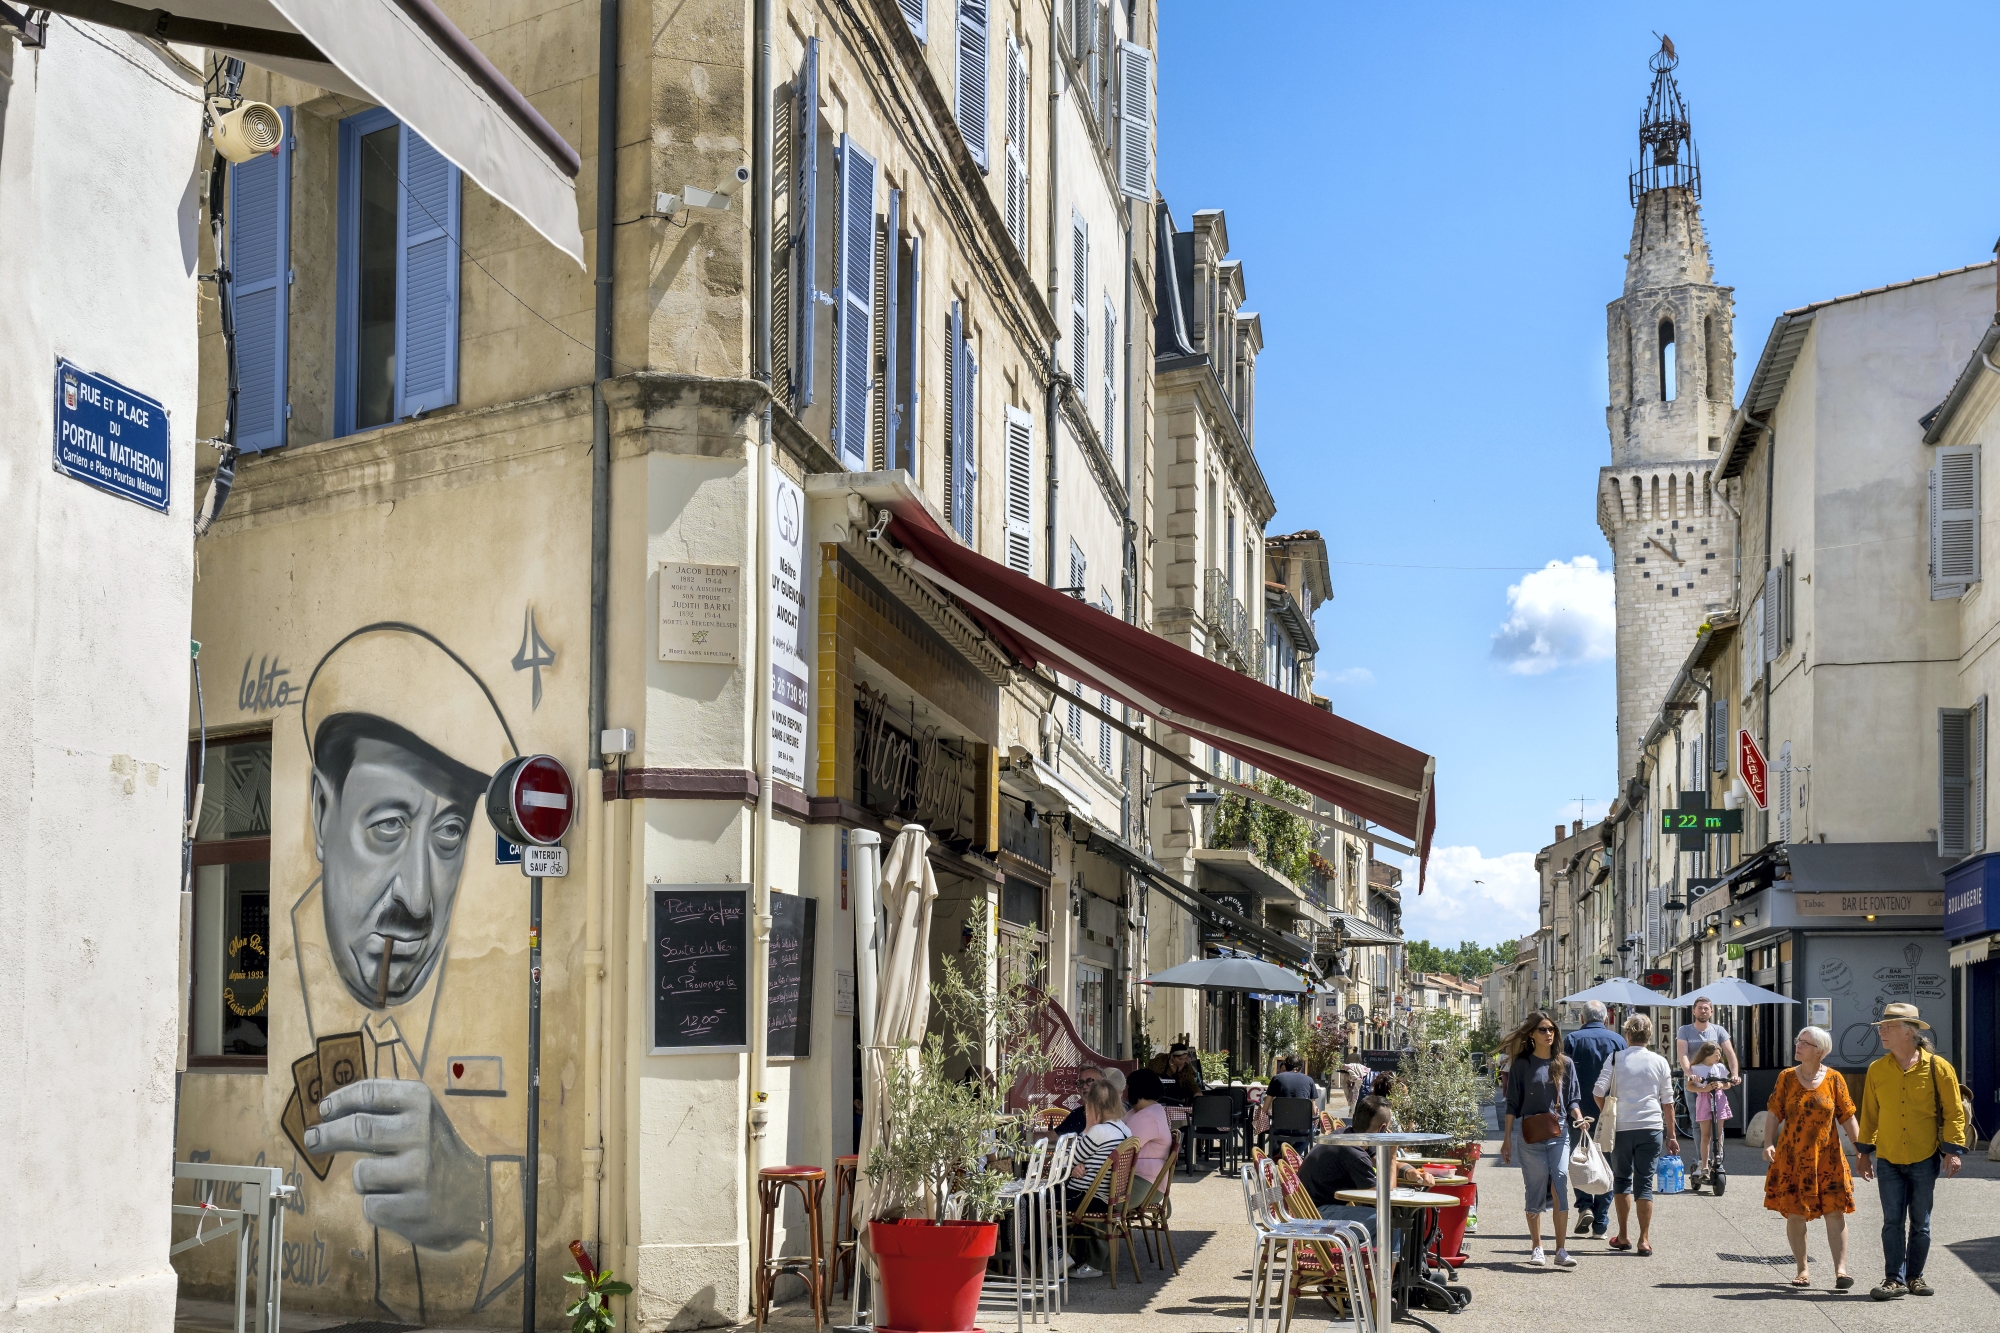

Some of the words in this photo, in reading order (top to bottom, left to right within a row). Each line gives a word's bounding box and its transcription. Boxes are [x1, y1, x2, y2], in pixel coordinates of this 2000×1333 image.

[80, 382, 100, 406] RUE
[104, 396, 114, 412] ET
[118, 400, 149, 428] PLACE
[110, 421, 120, 436] DU
[62, 420, 106, 458] PORTAIL
[110, 440, 164, 482] MATHERON
[64, 447, 88, 468] Carriero
[90, 462, 94, 470] e
[96, 462, 112, 479] Plaço
[114, 468, 136, 487] Pourtau
[136, 478, 162, 498] Materoun
[676, 566, 702, 575] JACOB
[706, 568, 728, 576] LEON
[696, 586, 732, 594] AUSCHWITZ
[672, 600, 700, 609] JUDITH
[704, 603, 731, 611] BARKI
[776, 604, 798, 630] AVOCAT
[777, 676, 786, 696] 26
[786, 681, 798, 702] 730
[914, 724, 964, 826] Bar
[1744, 744, 1764, 793] TABAC
[1679, 815, 1697, 827] 22
[532, 850, 562, 860] INTERDIT
[530, 863, 547, 871] SAUF
[1804, 899, 1825, 908] Tabac
[1842, 897, 1857, 911] BAR
[1859, 897, 1868, 910] LE
[1870, 896, 1912, 911] FONTENOY
[1948, 887, 1982, 915] BOULANGERIE
[228, 936, 247, 957] Mon
[250, 934, 266, 956] Bar
[229, 969, 246, 982] depuis
[248, 970, 263, 979] 1933
[223, 987, 246, 1016] Plaisir
